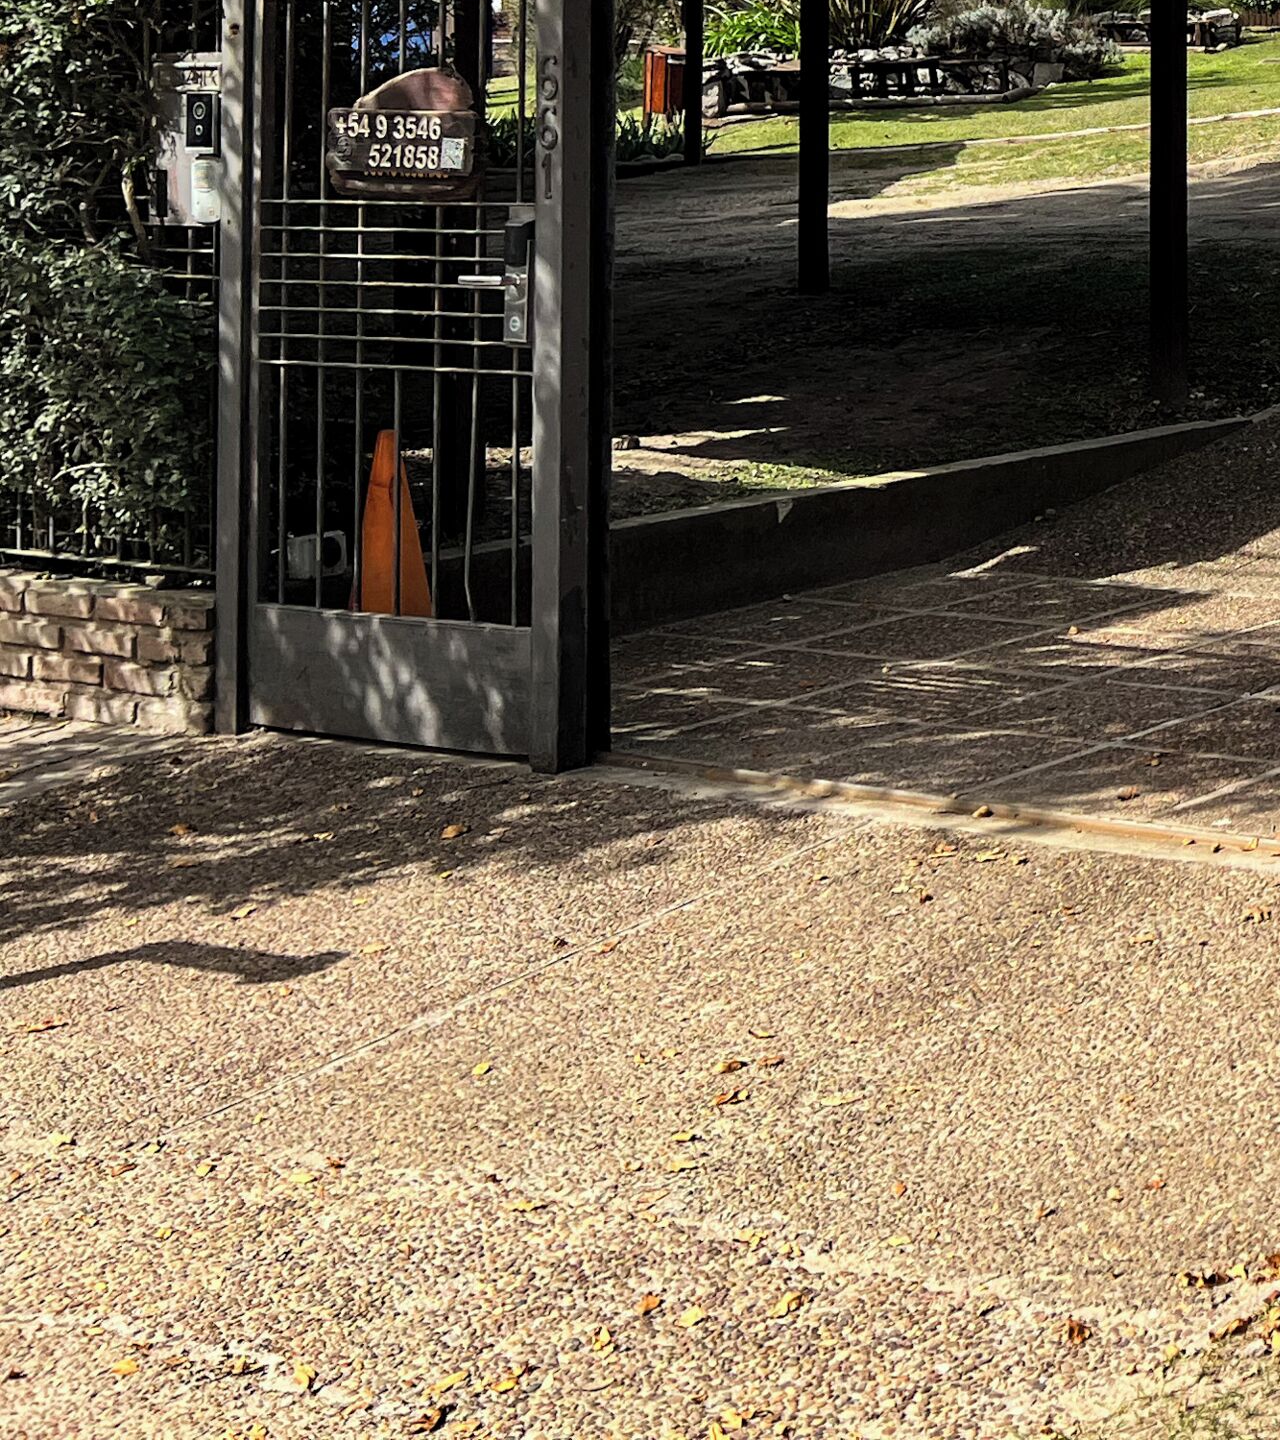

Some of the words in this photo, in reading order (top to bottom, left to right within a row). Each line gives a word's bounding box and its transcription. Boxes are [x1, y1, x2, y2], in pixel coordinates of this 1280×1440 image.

[335, 112, 371, 138] +54
[375, 114, 388, 139] 9
[392, 115, 442, 141] 3546
[540, 55, 559, 200] 661
[367, 143, 440, 170] 521858
